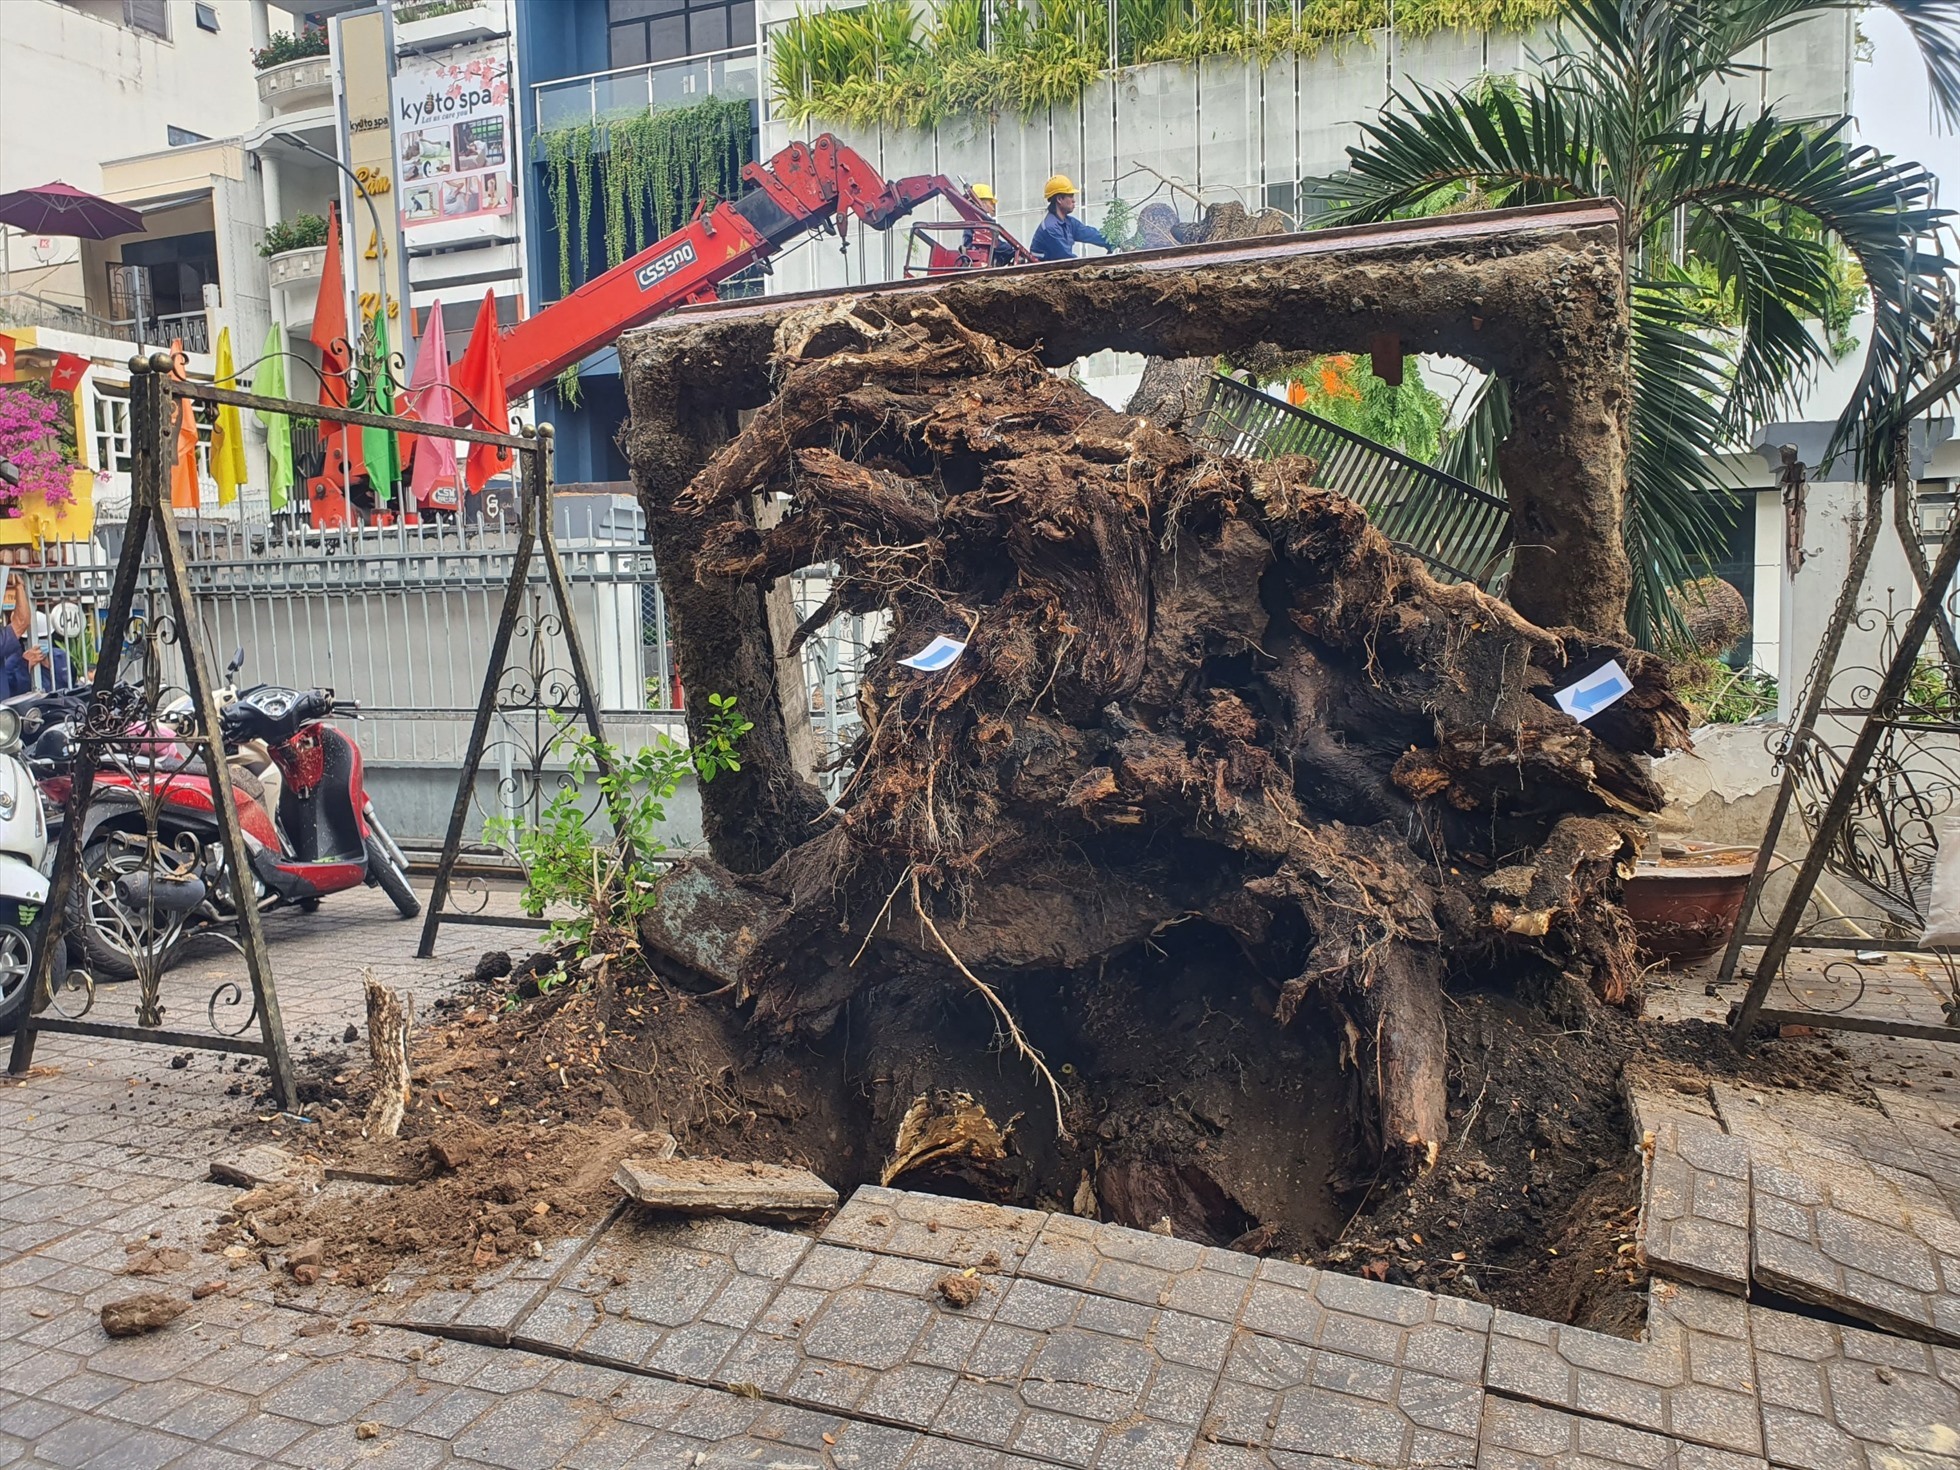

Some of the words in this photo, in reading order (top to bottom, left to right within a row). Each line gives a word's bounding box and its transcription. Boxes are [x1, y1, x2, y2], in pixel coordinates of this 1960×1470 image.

[401, 88, 455, 125] kyoto
[459, 89, 492, 114] spa
[442, 112, 455, 120] care
[456, 110, 468, 119] you
[374, 117, 388, 126] spa
